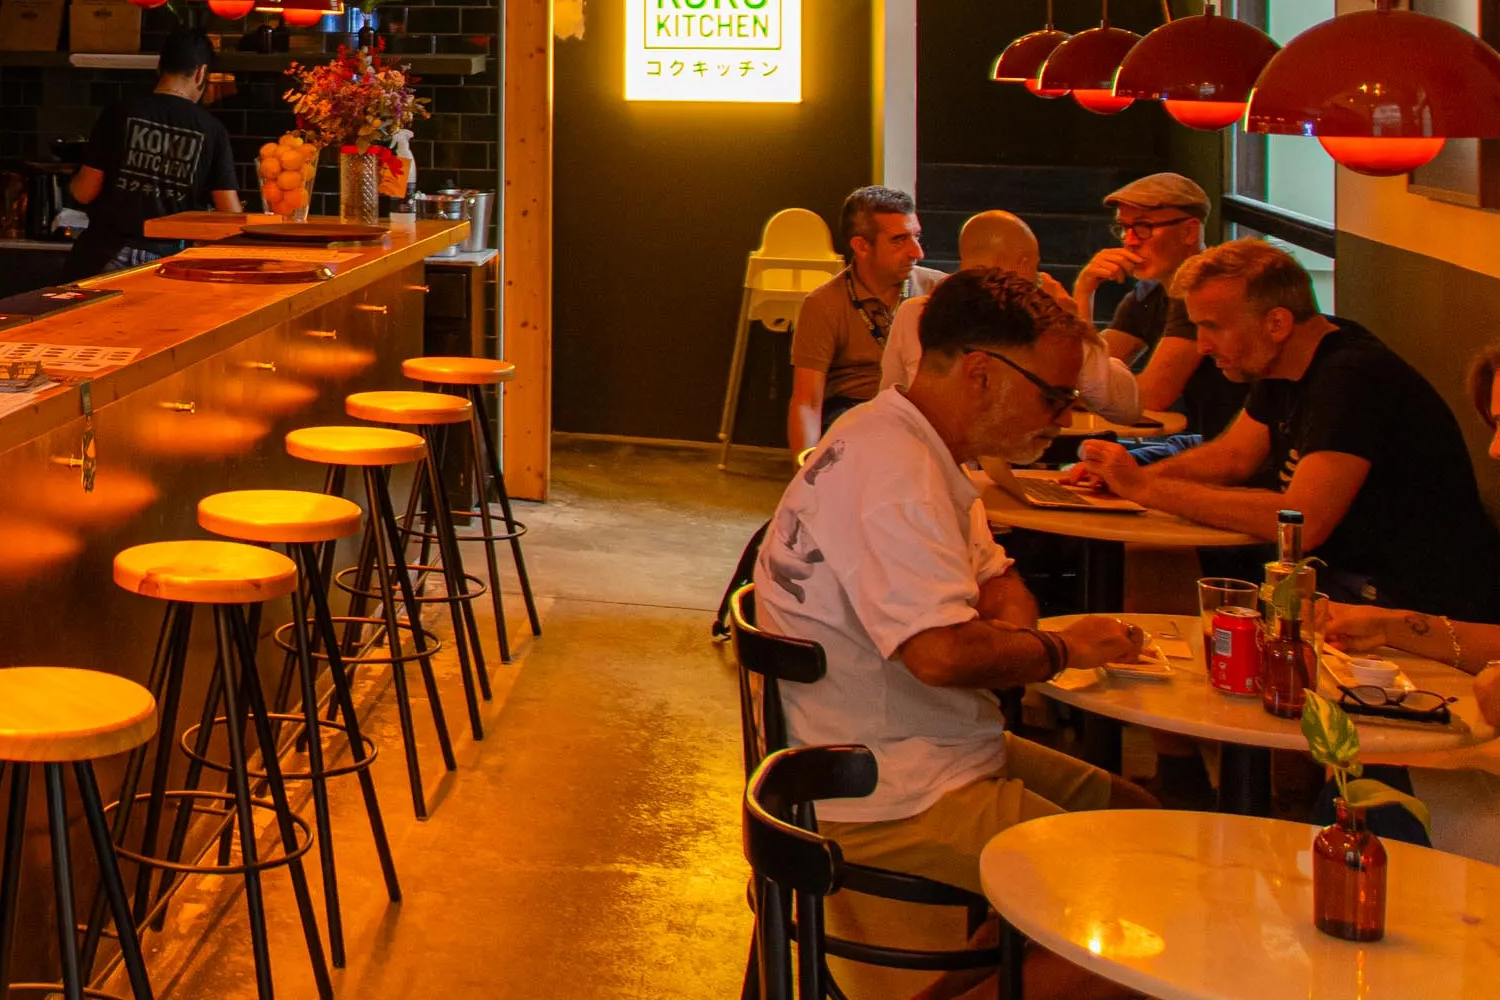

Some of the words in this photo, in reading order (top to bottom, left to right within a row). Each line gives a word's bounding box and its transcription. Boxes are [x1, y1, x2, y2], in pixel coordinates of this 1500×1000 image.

[656, 14, 769, 38] KITCHEN
[646, 59, 779, 77] コクキッチン
[130, 125, 197, 160] KOKU
[127, 150, 191, 178] KITCHEN
